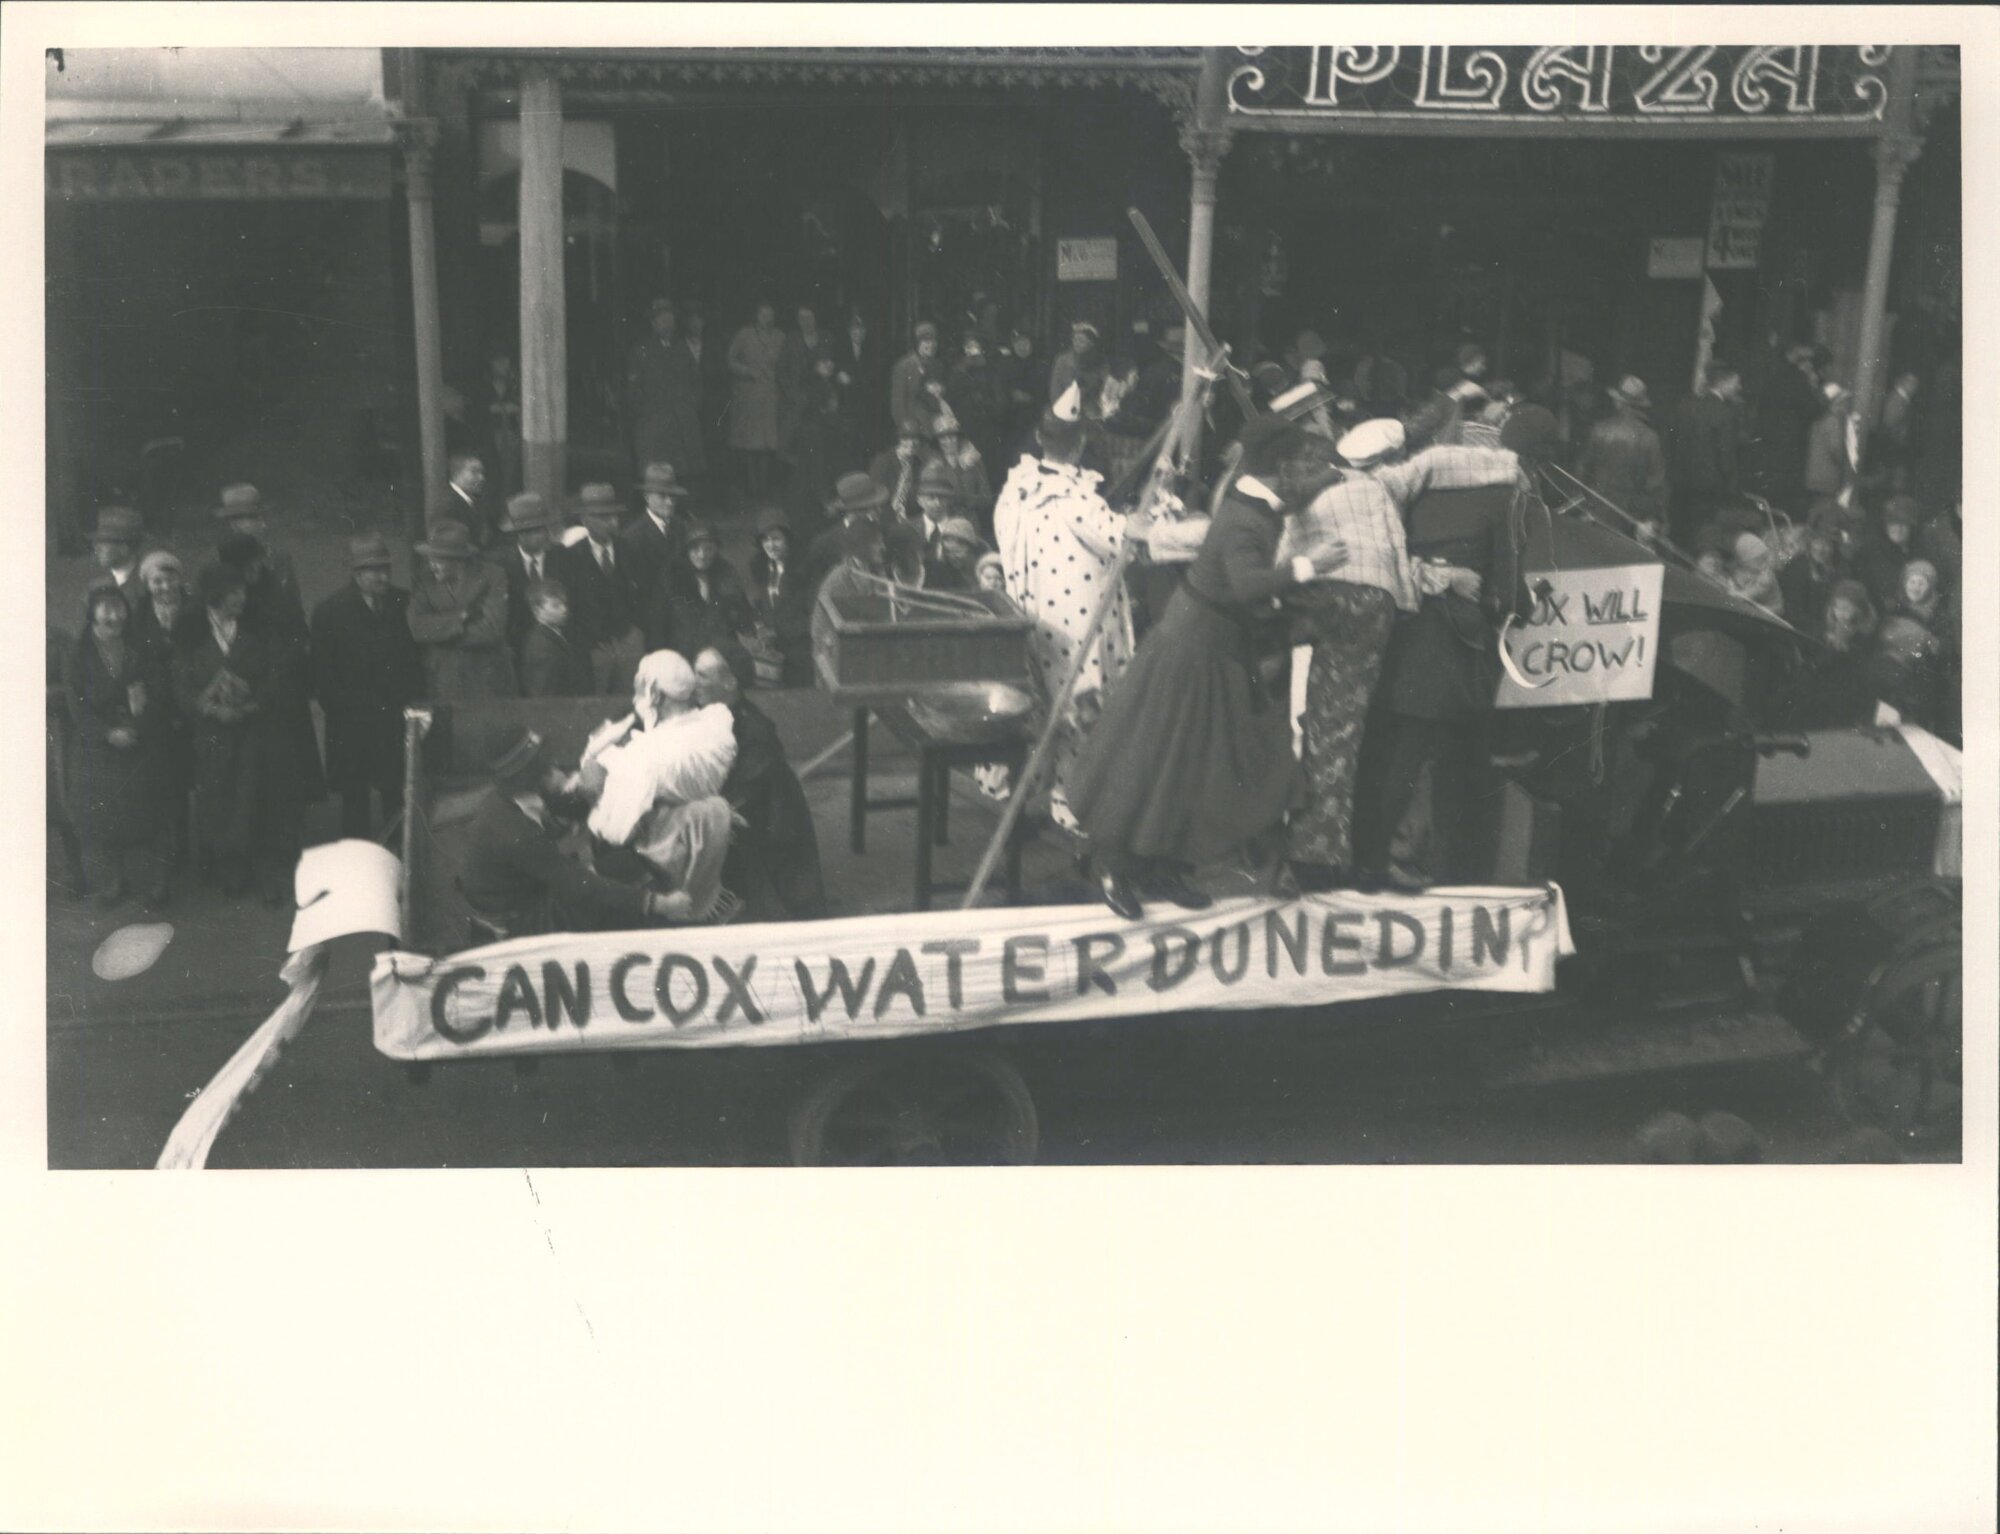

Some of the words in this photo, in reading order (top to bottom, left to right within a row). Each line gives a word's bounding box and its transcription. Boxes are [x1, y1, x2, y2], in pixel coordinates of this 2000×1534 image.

[1305, 45, 1817, 112] PLAZA
[1582, 587, 1649, 623] WILL
[1521, 635, 1646, 676] CROW!
[430, 960, 592, 1044] CAN
[608, 952, 764, 1029] COX
[794, 932, 1126, 1023] WATER
